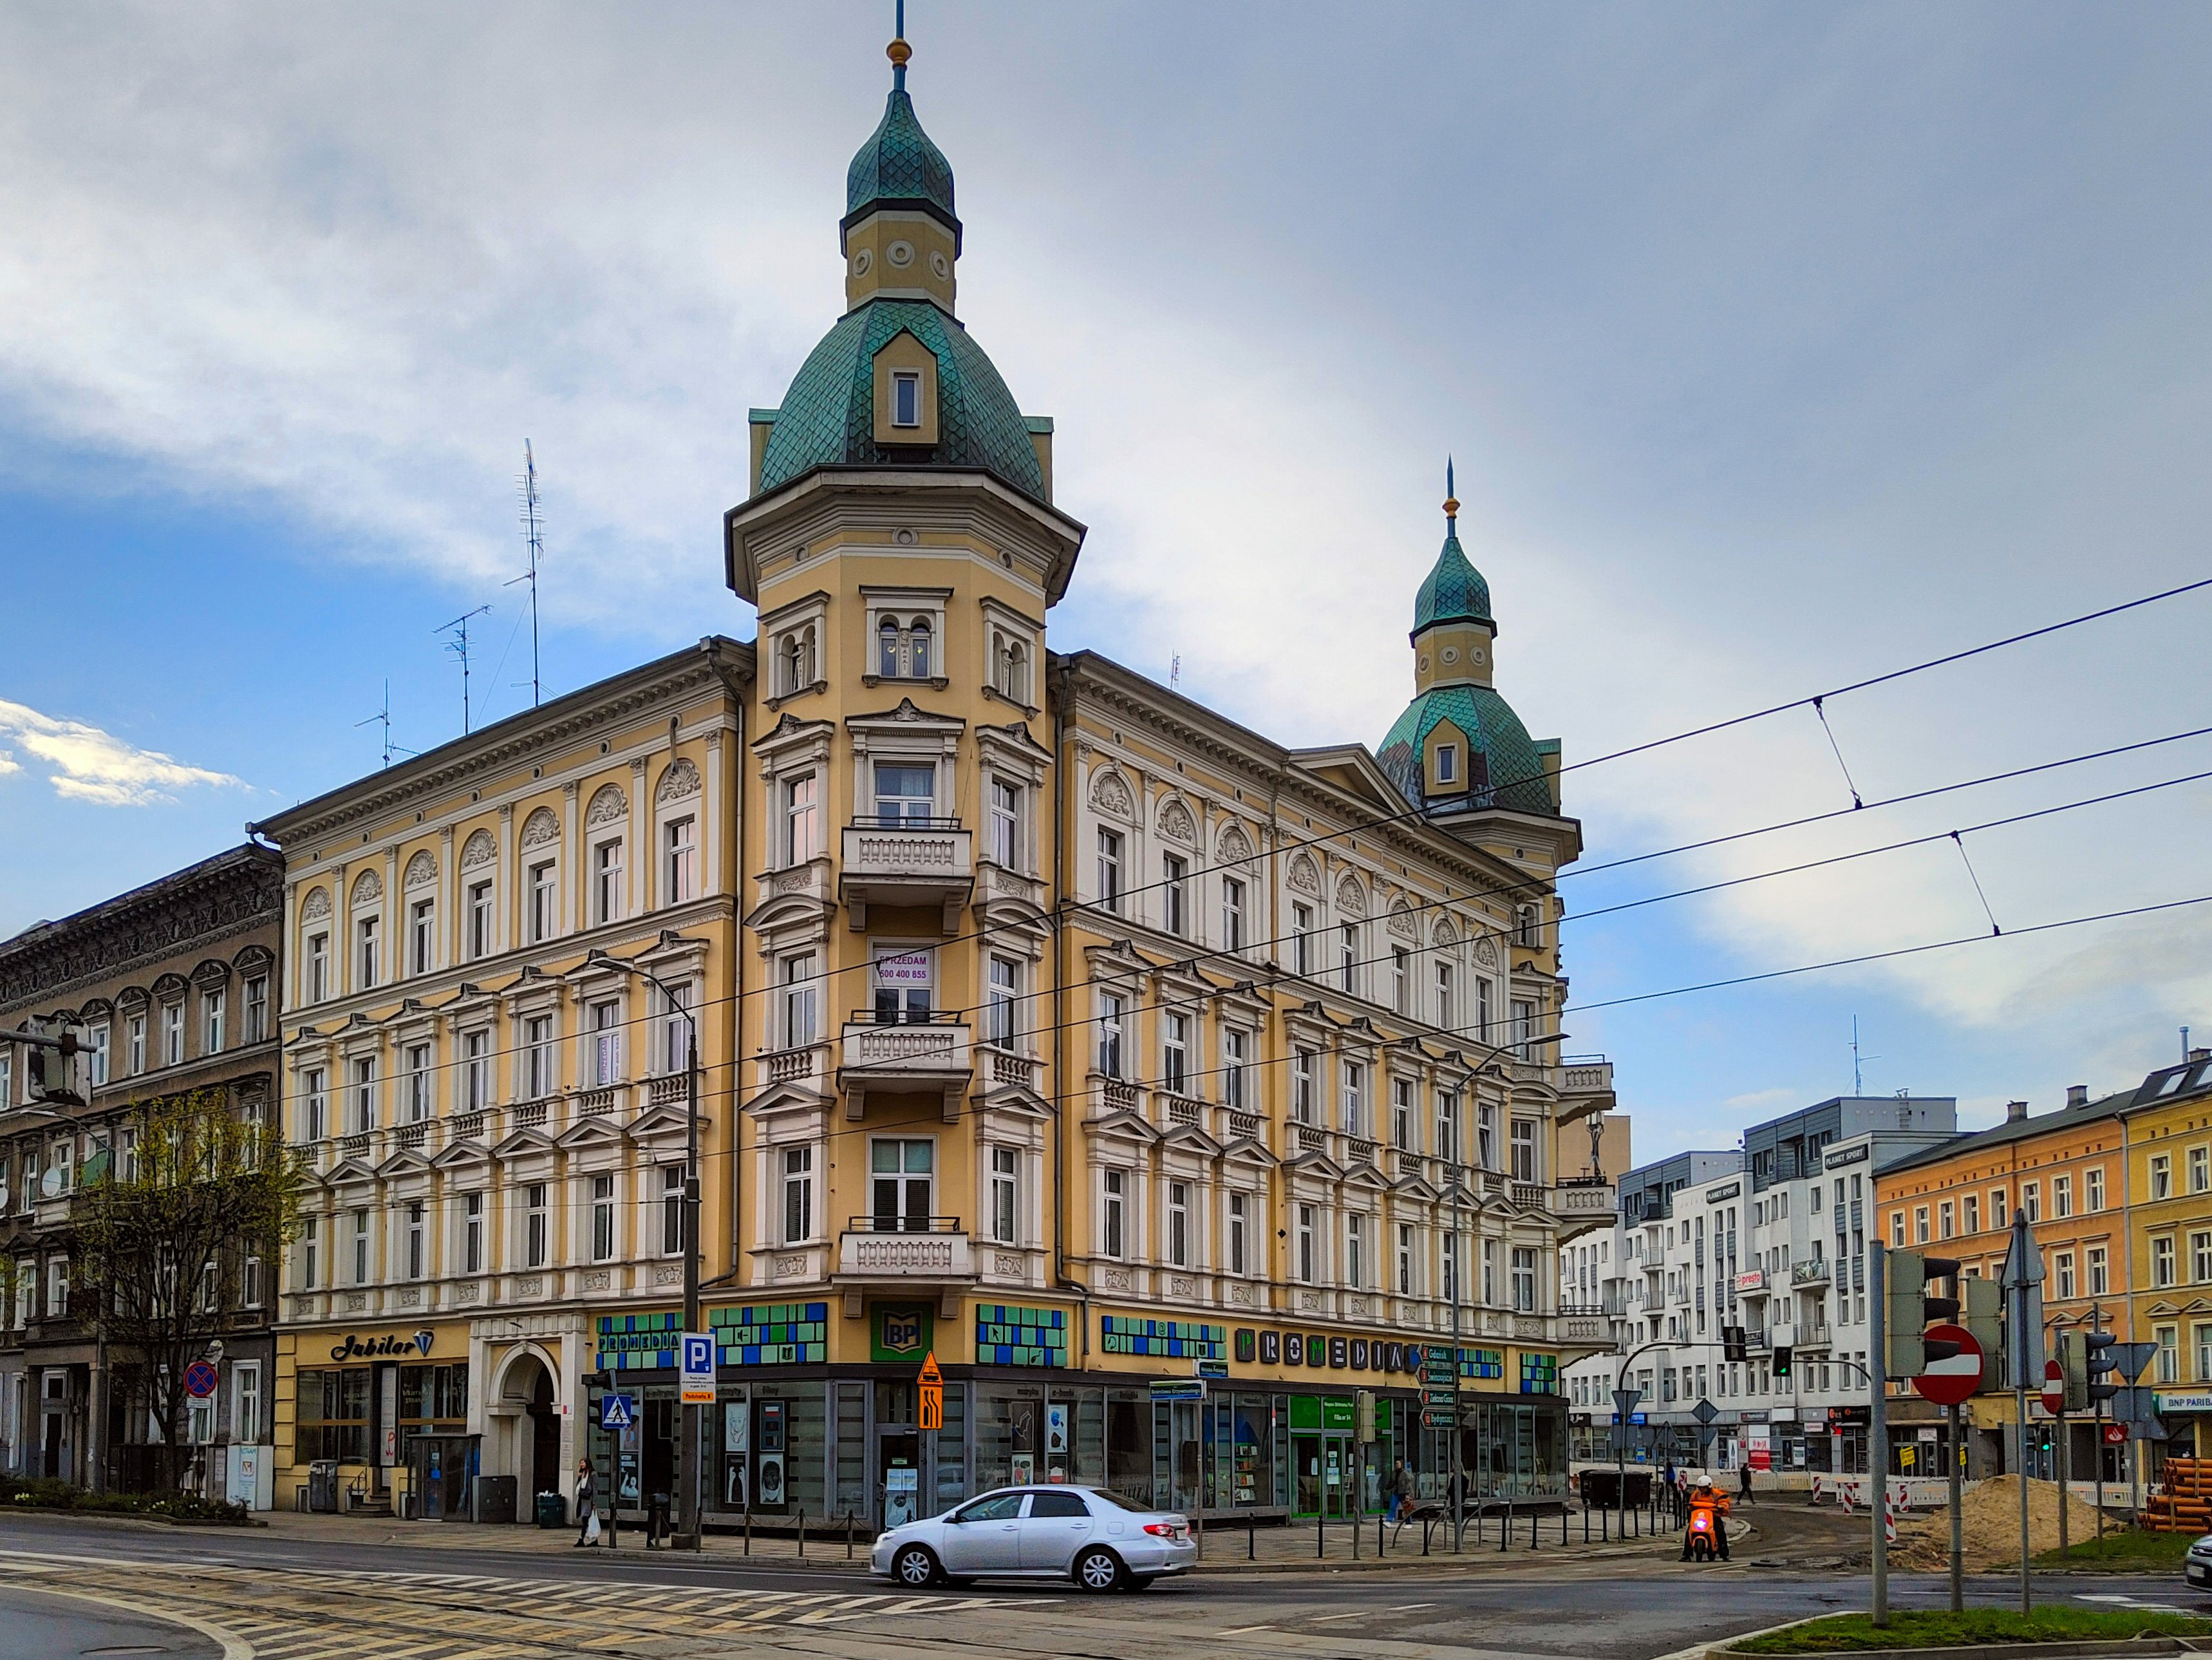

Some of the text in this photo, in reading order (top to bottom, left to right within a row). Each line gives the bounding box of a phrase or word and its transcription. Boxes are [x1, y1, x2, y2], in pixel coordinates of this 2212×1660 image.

[879, 956, 926, 965] SPRZEDAM
[895, 970, 910, 978] 400
[1826, 1148, 1864, 1165] PLANET SPORT
[1707, 1185, 1737, 1200] PLANET SPORT
[1741, 1272, 1761, 1286] presto
[599, 1335, 679, 1350] PROMEDIA
[1241, 1332, 1401, 1368] PROMEDIA
[2168, 1398, 2212, 1407] BNP PARIB
